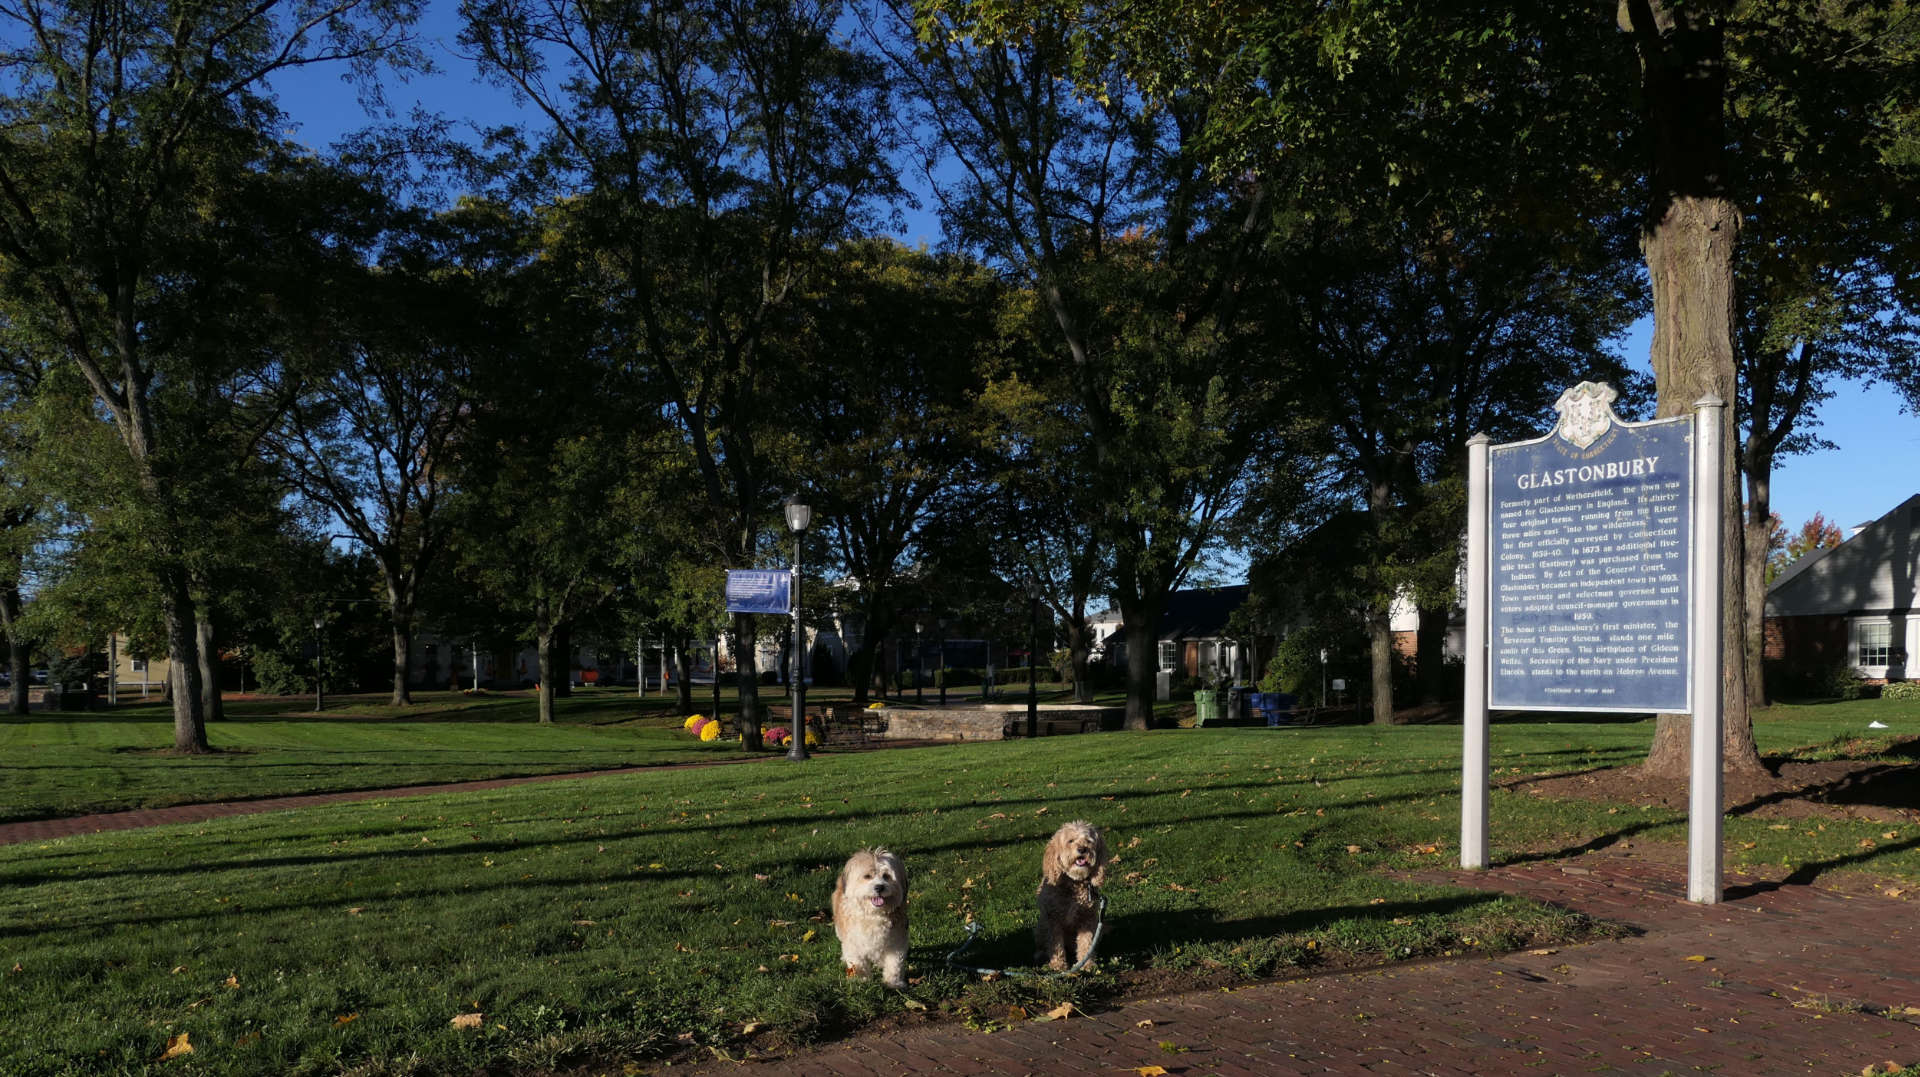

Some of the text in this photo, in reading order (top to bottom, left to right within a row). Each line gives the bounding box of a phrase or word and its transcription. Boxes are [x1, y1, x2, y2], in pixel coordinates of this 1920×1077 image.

[1517, 456, 1659, 490] GLASTONBURY
[1501, 499, 1530, 509] Formerly
[1534, 496, 1549, 505] part
[1554, 494, 1561, 502] of
[1623, 486, 1636, 494] the
[1641, 484, 1660, 492] town
[1501, 510, 1522, 519] named
[1525, 508, 1536, 516] for
[1539, 504, 1582, 515] Glastonbury
[1586, 501, 1594, 509] in
[1520, 518, 1547, 528] original
[1581, 511, 1610, 521] running
[1614, 509, 1633, 517] from
[1654, 505, 1677, 513] River
[1518, 541, 1533, 549] first
[1537, 537, 1570, 546] officially
[1574, 534, 1609, 543] surveyed
[1613, 532, 1623, 541] by
[1628, 528, 1677, 539] Connecticut
[1571, 547, 1580, 555] In
[1616, 541, 1656, 551] additional
[1501, 563, 1515, 571] mile
[1599, 553, 1640, 565] purchased
[1643, 552, 1662, 560] from
[1665, 551, 1679, 559] the
[1544, 571, 1553, 579] By
[1558, 569, 1571, 577] Act
[1588, 567, 1600, 575] the
[1605, 565, 1636, 574] General
[1500, 583, 1540, 592] Glastonbury
[1541, 581, 1568, 590] became
[1580, 577, 1625, 588] independent
[1648, 575, 1656, 583] in
[1576, 590, 1614, 599] selectmen
[1618, 586, 1655, 598] governed
[1660, 585, 1680, 594] until
[1525, 603, 1554, 612] adopted
[1556, 600, 1618, 610] council-manager
[1622, 598, 1668, 608] government
[1671, 596, 1680, 605] in
[1501, 625, 1513, 634] The
[1517, 625, 1534, 633] home
[1538, 625, 1546, 633] of
[1549, 623, 1600, 633] Glastonbury's
[1602, 623, 1620, 631] first
[1665, 621, 1679, 629] the
[1504, 636, 1537, 644] Reverend
[1540, 635, 1569, 644] Timothy
[1609, 633, 1633, 642] stands
[1637, 633, 1653, 641] one
[1656, 632, 1675, 640] mile
[1500, 647, 1518, 655] south
[1578, 645, 1593, 654] The
[1596, 645, 1635, 655] birthplace
[1638, 644, 1647, 653] of
[1651, 644, 1679, 653] Gideon
[1529, 657, 1564, 666] Secretary
[1567, 657, 1575, 665] of
[1593, 656, 1612, 666] Navy
[1615, 656, 1638, 664] under
[1641, 655, 1679, 664] President
[1580, 667, 1600, 675] north
[1616, 667, 1646, 675] Hebron
